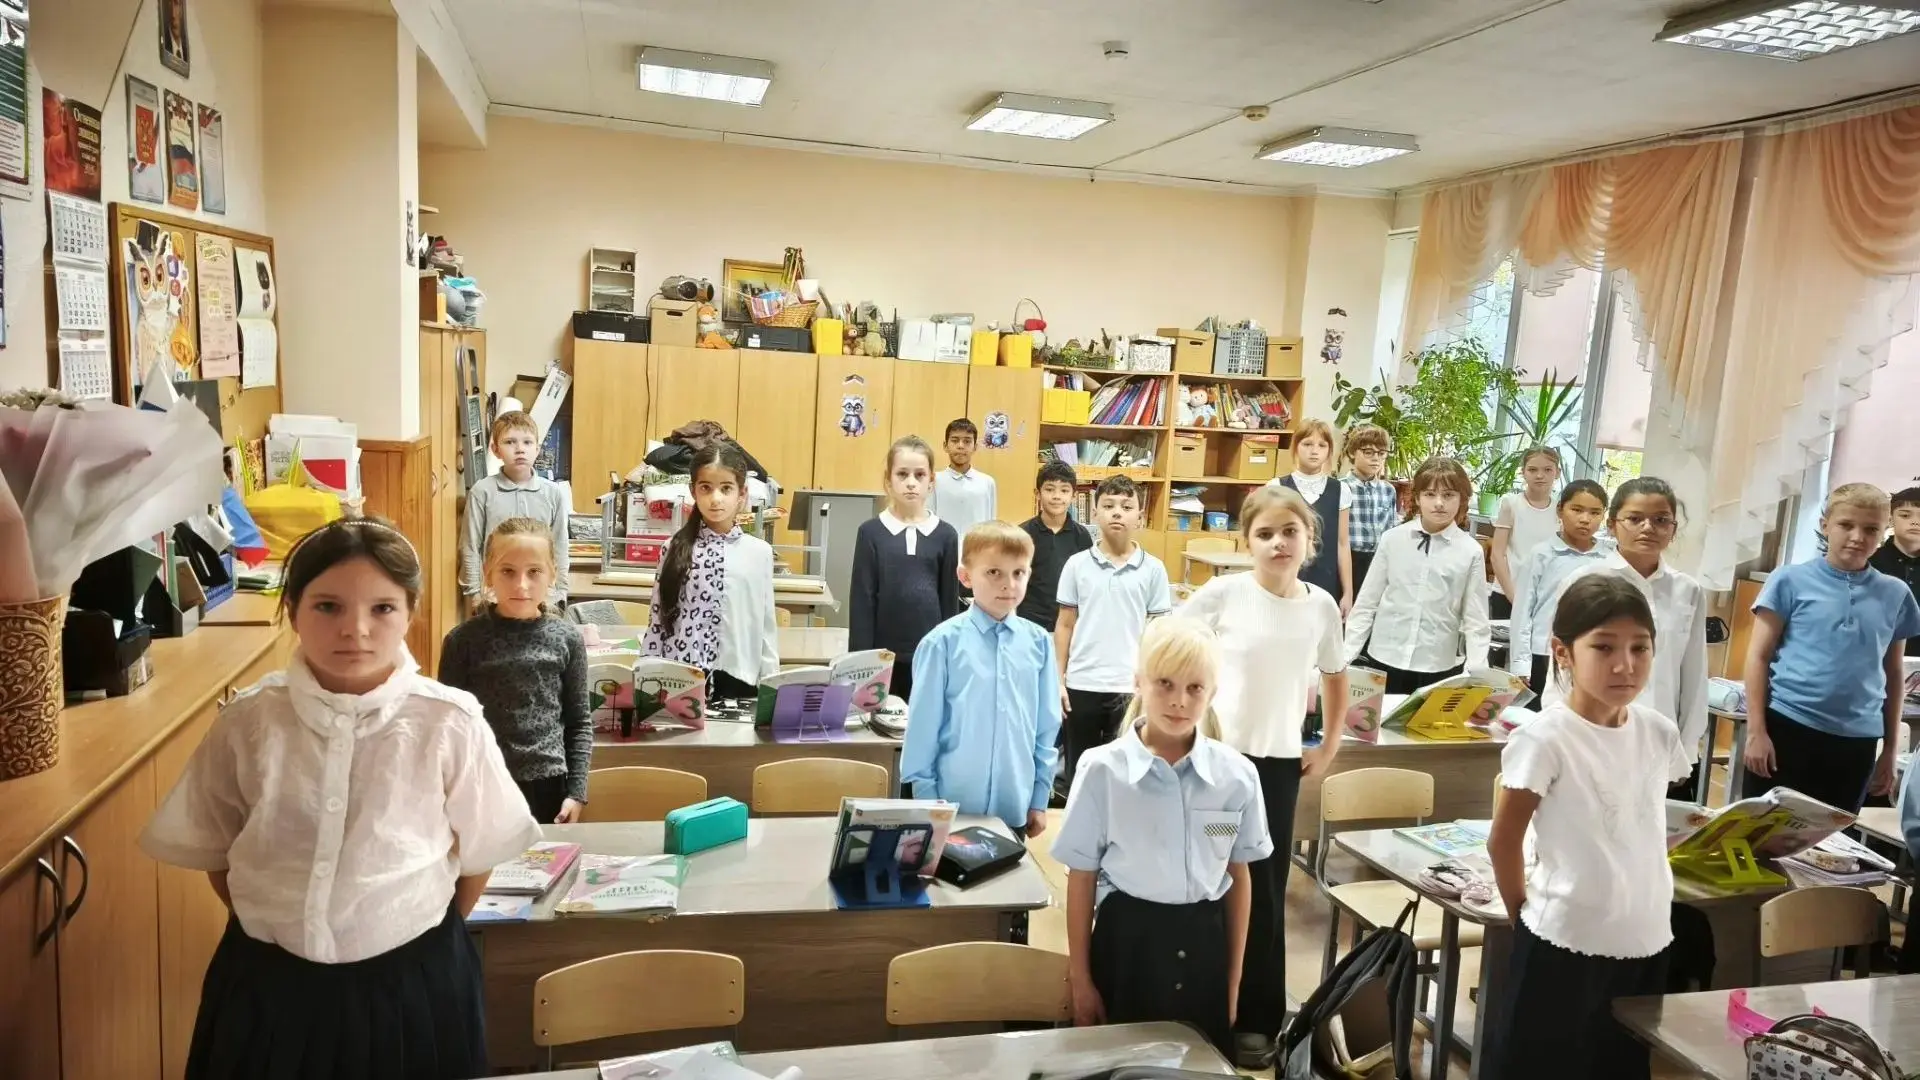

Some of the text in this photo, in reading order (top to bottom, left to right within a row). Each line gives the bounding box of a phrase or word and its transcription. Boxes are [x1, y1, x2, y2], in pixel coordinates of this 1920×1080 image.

[862, 681, 886, 707] 3
[678, 695, 702, 720] 3
[1352, 705, 1378, 733] 3
